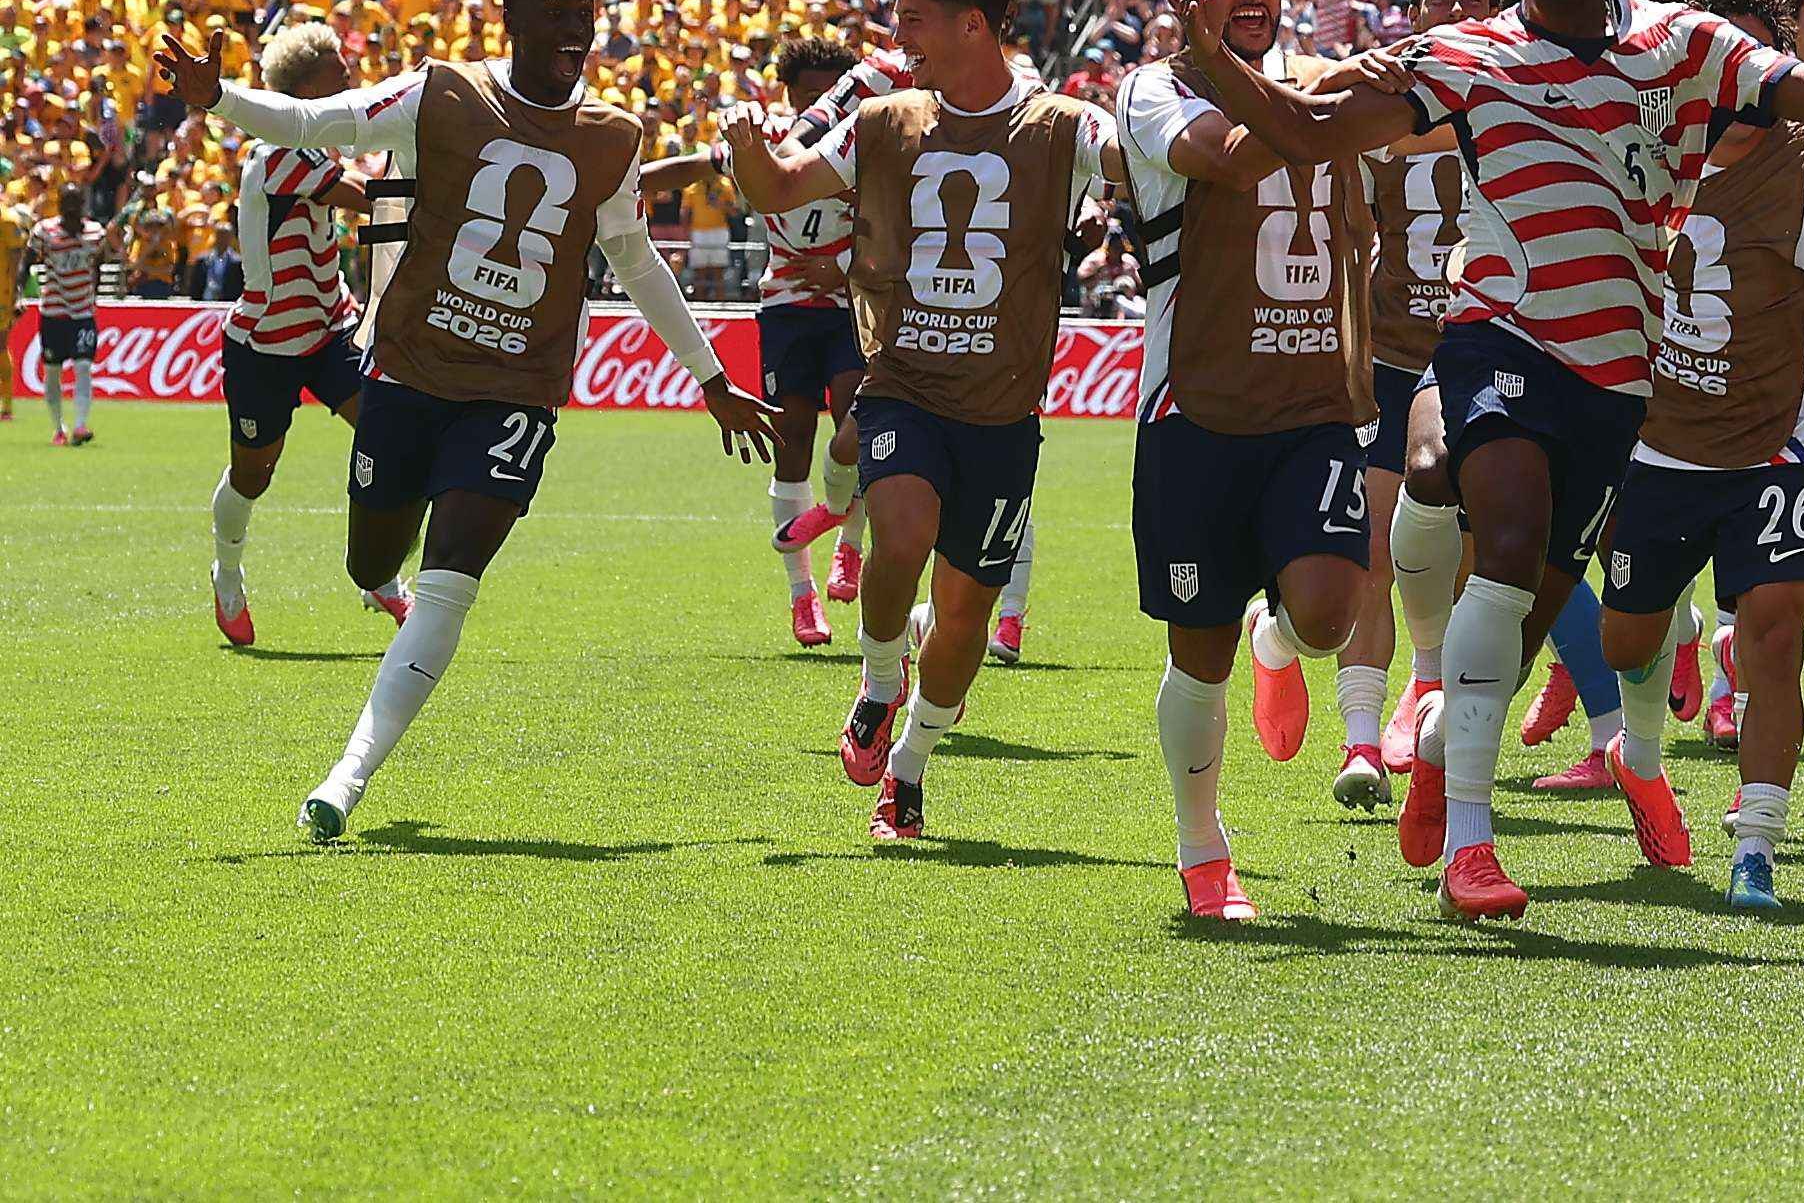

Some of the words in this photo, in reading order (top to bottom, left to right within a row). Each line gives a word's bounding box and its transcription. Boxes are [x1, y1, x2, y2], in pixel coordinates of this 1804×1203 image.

[1640, 89, 1669, 110] USA
[801, 209, 822, 243] 4
[474, 266, 519, 294] FIFA
[932, 276, 976, 294] FIFA
[1285, 265, 1320, 284] FIFA
[1406, 284, 1450, 296] WOR
[435, 289, 497, 321] WORLD
[499, 313, 533, 331] CUP
[902, 308, 962, 329] WORLD
[965, 315, 998, 330] CUP
[1253, 307, 1309, 325] WORLD
[1313, 307, 1334, 325] CUP
[1408, 298, 1450, 317] 20
[76, 328, 96, 353] 20
[426, 306, 528, 355] 2026
[895, 325, 995, 354] 2026
[1251, 326, 1339, 355] 2026
[1658, 342, 1692, 367] ORLD
[1694, 357, 1731, 374] CUP
[1654, 355, 1728, 397] 026
[487, 411, 547, 471] 21
[873, 431, 896, 446] USA
[1318, 459, 1366, 520] 15
[981, 496, 1030, 550] 14
[1171, 564, 1197, 580] USA
